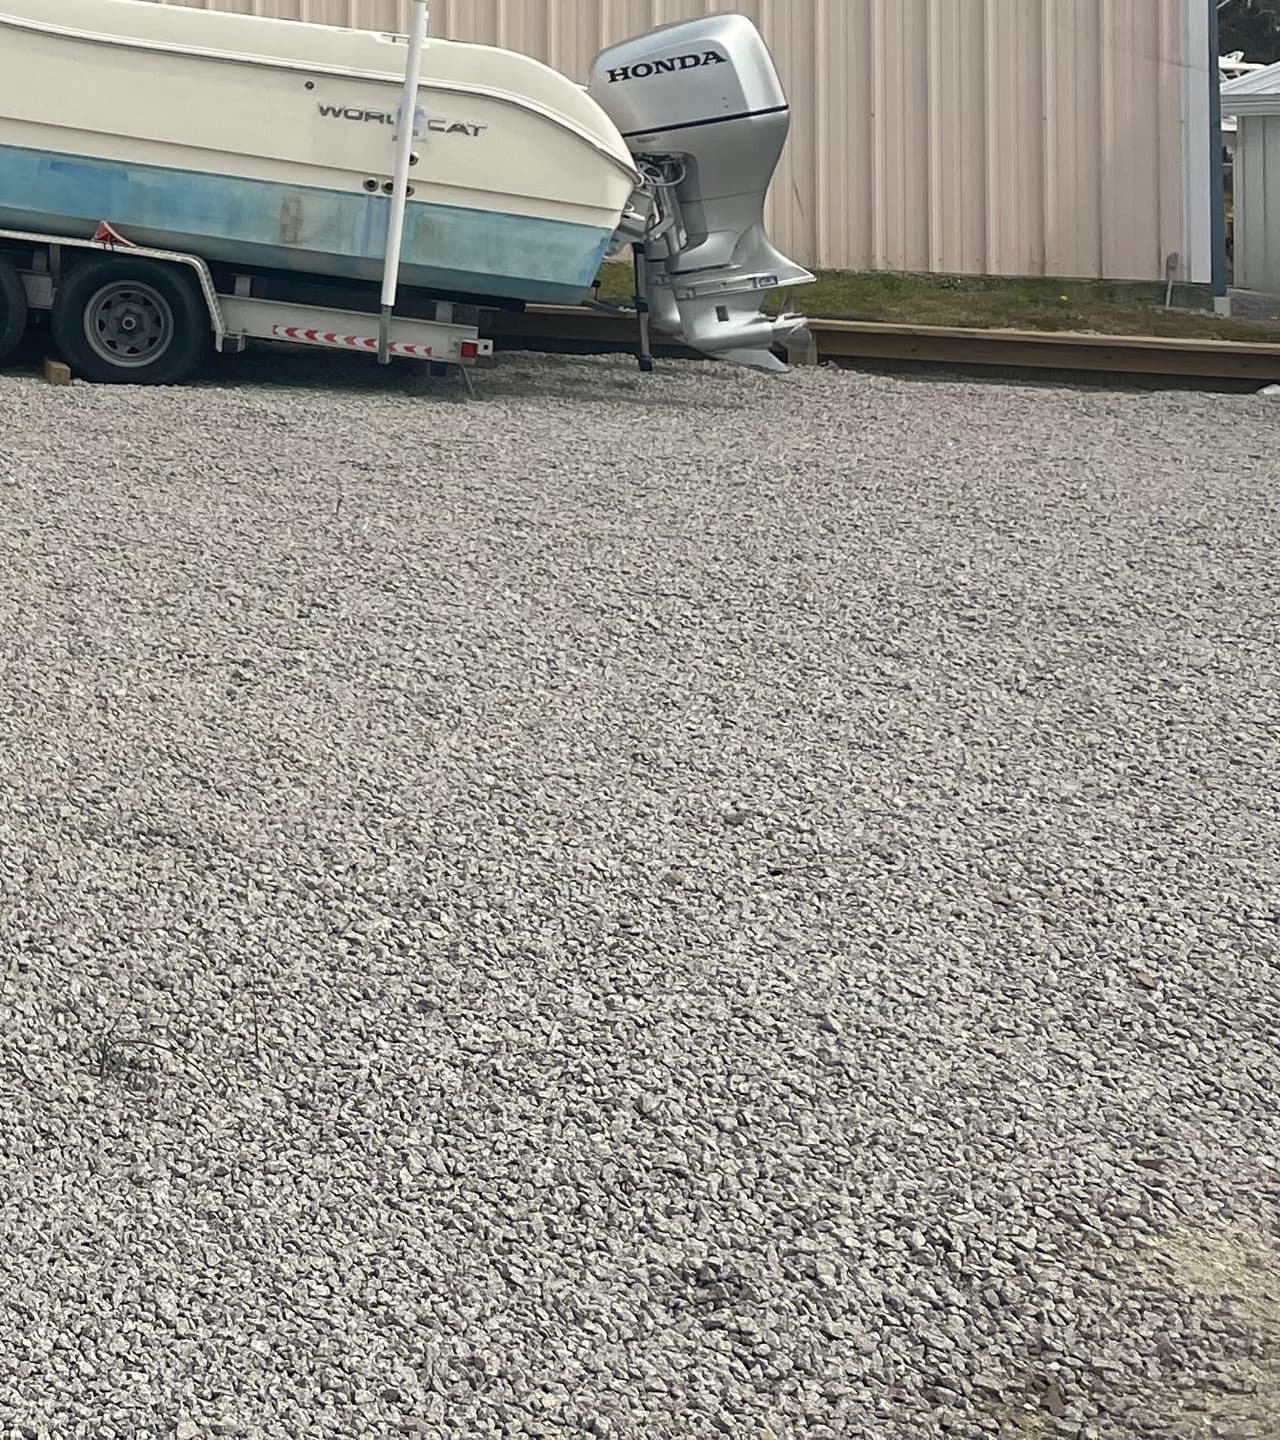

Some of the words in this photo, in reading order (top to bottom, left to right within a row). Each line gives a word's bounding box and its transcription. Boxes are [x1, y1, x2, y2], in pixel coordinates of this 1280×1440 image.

[606, 50, 727, 84] HONDA
[317, 103, 396, 125] WORL
[427, 119, 488, 137] CAT
